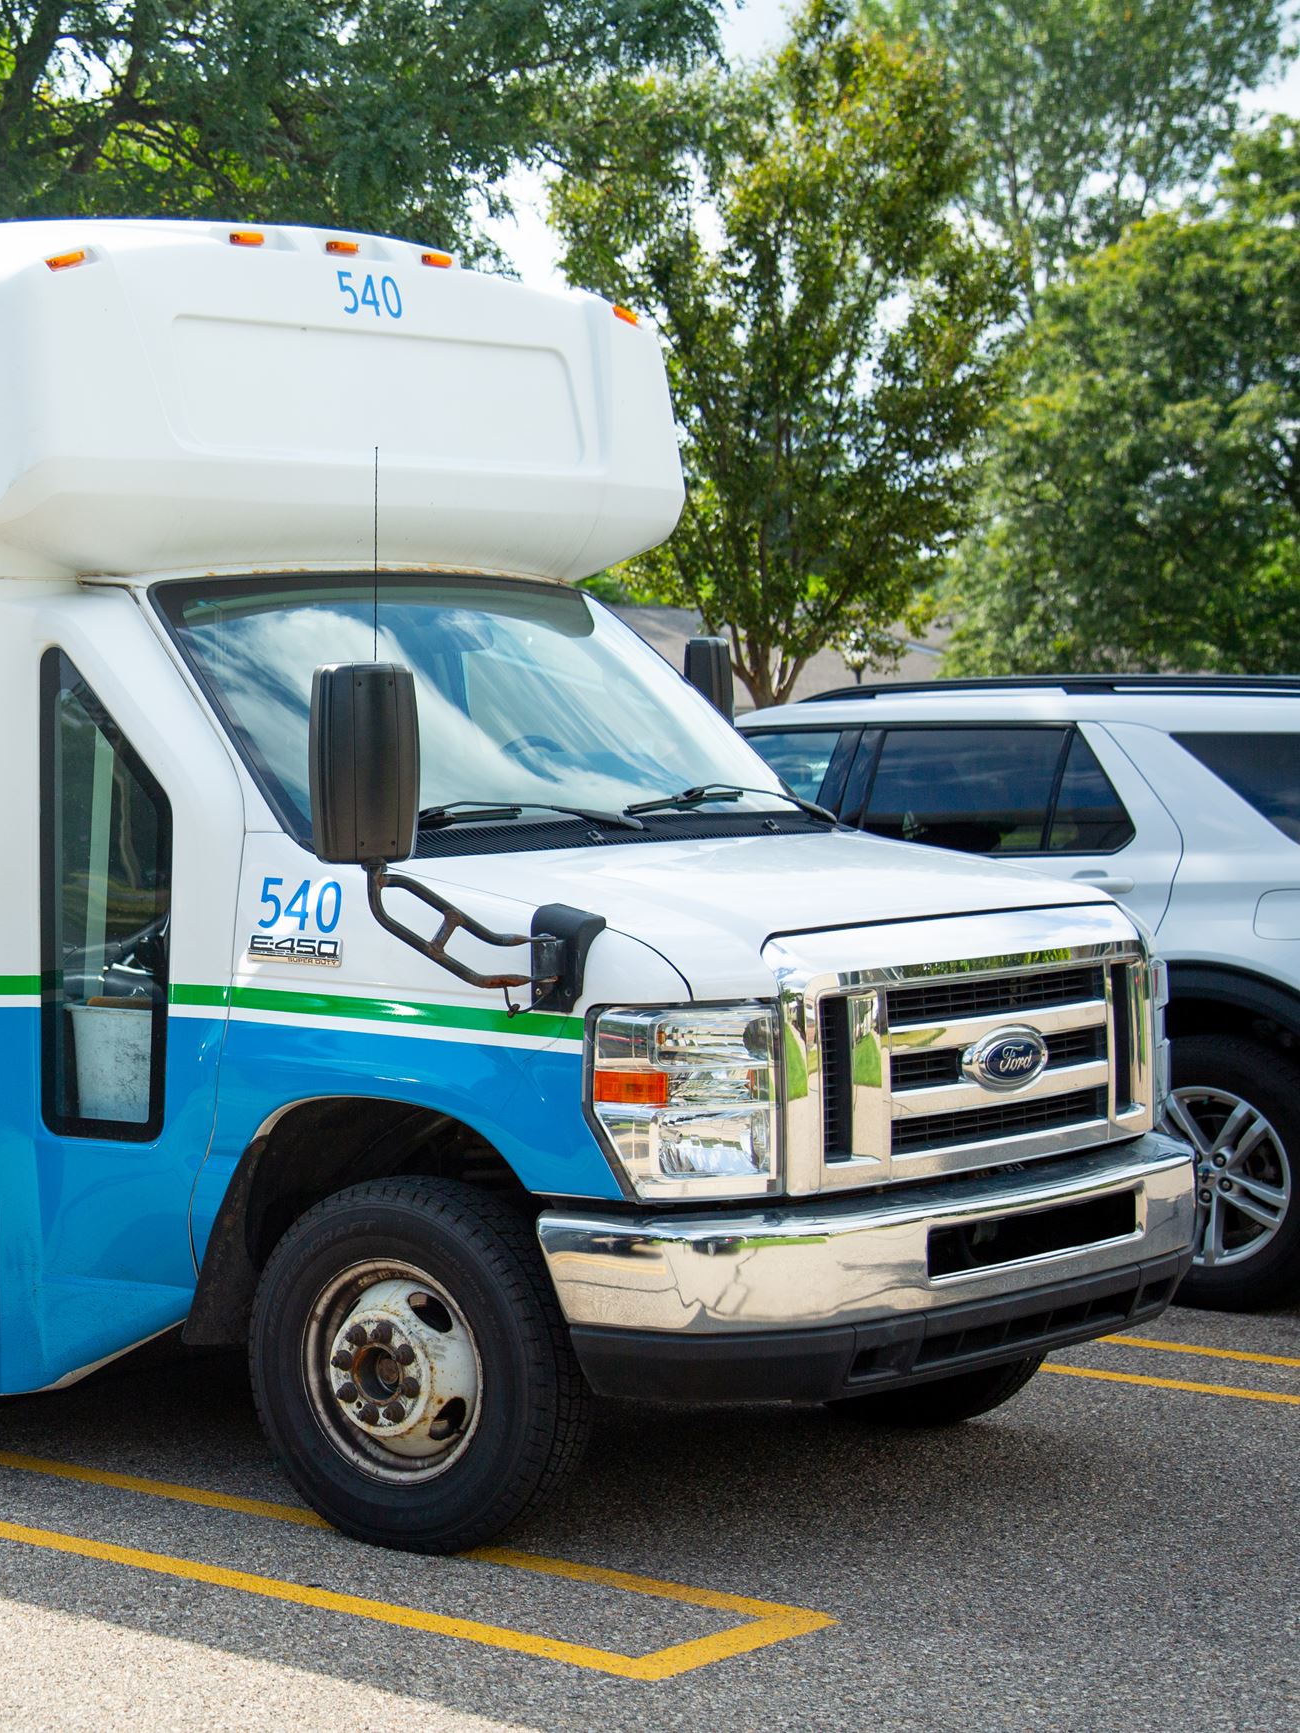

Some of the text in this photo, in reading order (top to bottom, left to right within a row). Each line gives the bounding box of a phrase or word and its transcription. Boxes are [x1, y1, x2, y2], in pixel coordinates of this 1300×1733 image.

[336, 270, 402, 319] 540
[257, 876, 342, 933] 540
[288, 956, 313, 965] SUPER
[999, 1045, 1033, 1072] Ford
